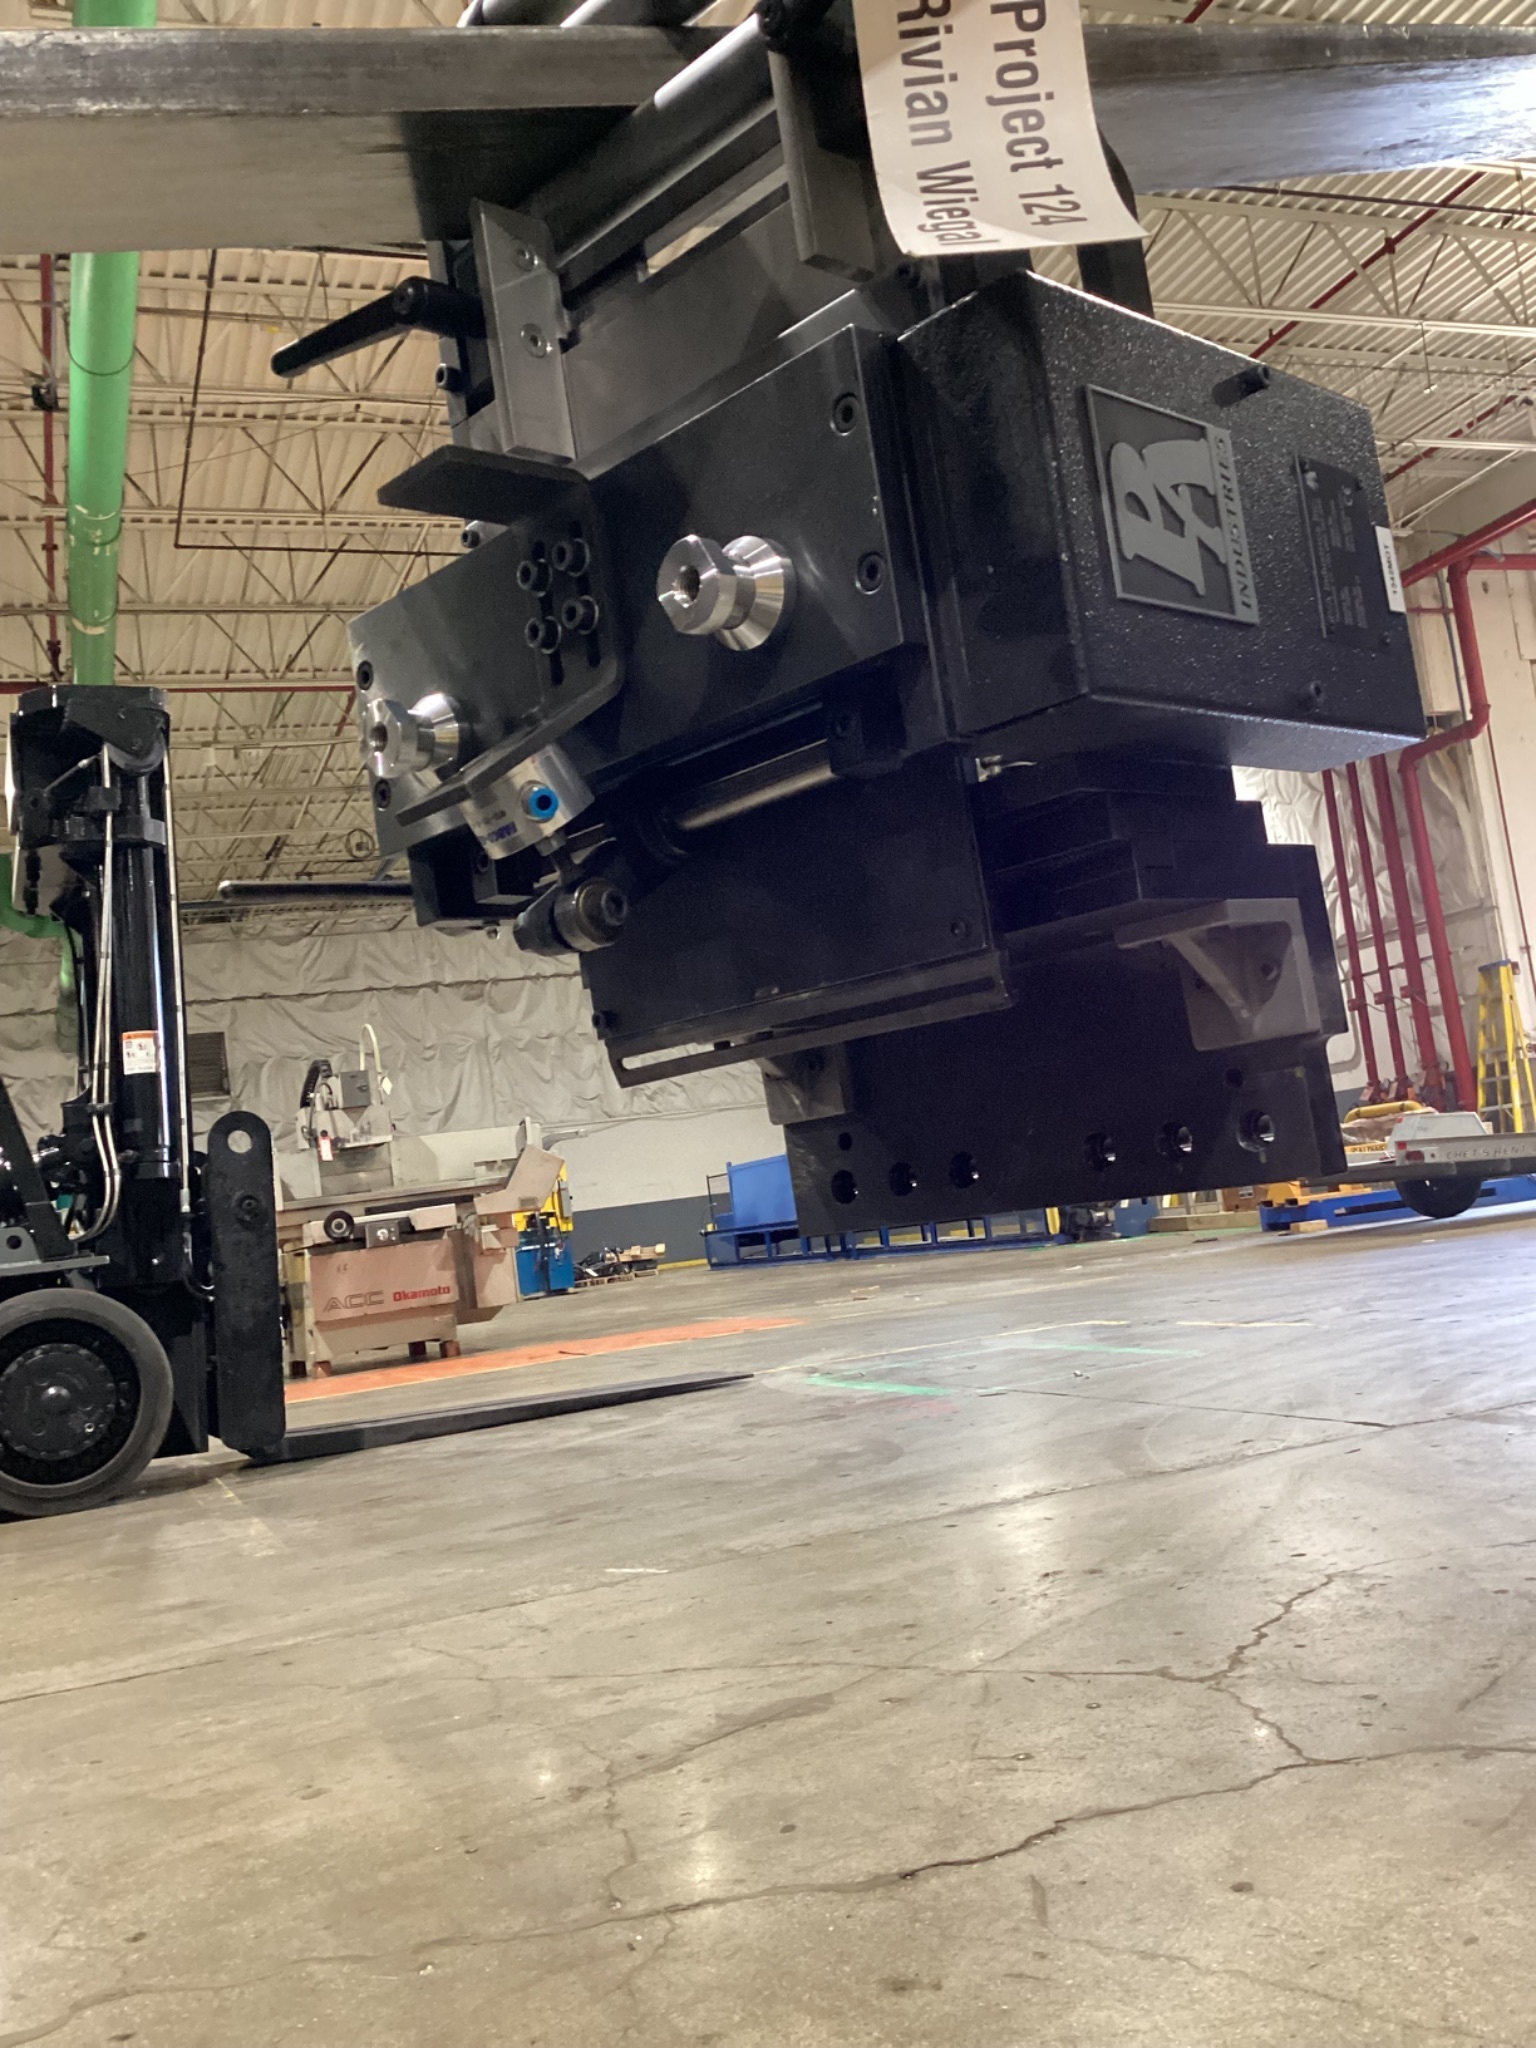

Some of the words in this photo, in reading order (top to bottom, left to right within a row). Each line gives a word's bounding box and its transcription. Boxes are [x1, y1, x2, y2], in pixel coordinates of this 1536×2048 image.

[896, 0, 958, 147] Rivian
[985, 0, 1063, 172] Project
[916, 160, 999, 246] Wiegal
[1018, 184, 1088, 226] 124
[1214, 435, 1252, 609] INDUSTRIES
[323, 1290, 384, 1313] ACC
[393, 1286, 450, 1302] Okamoto
